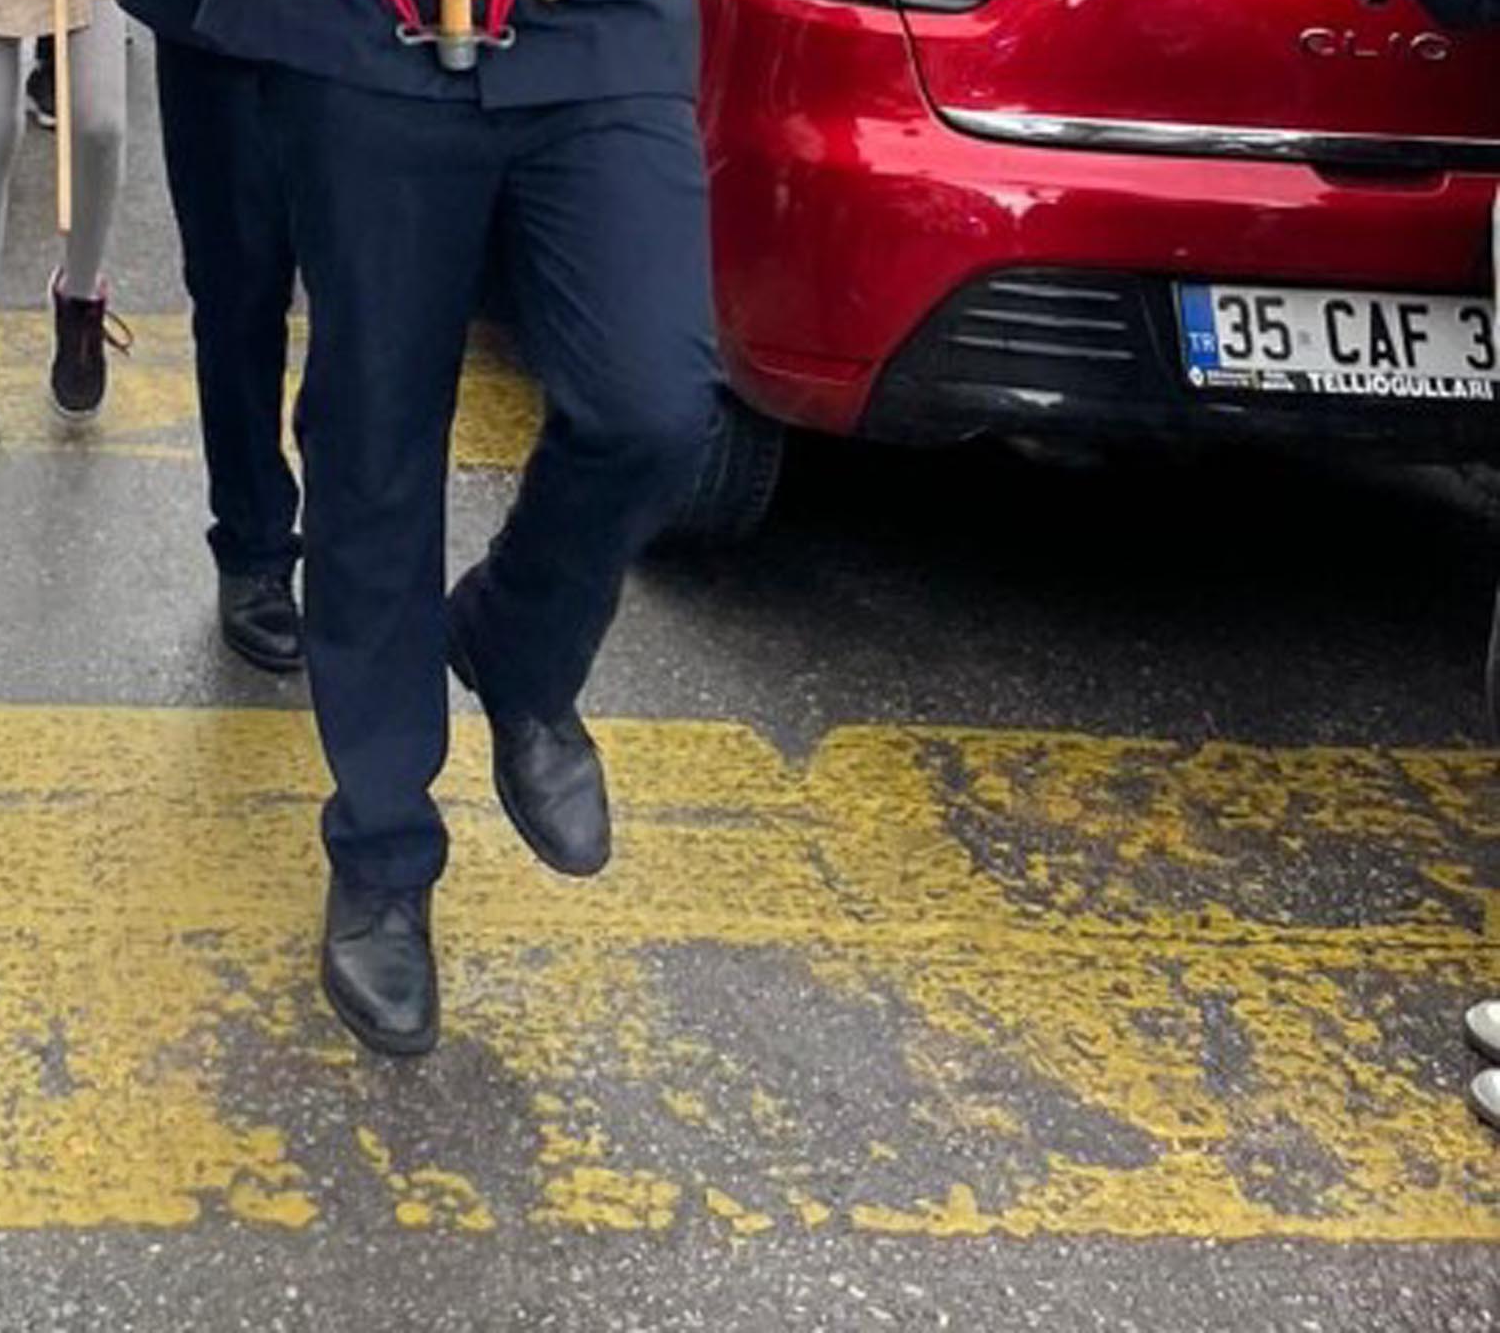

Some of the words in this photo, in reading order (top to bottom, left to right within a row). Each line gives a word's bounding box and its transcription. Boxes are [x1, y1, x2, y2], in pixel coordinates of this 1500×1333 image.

[1218, 295, 1292, 361] 35
[1323, 299, 1428, 368] CAF
[1458, 306, 1495, 371] 3
